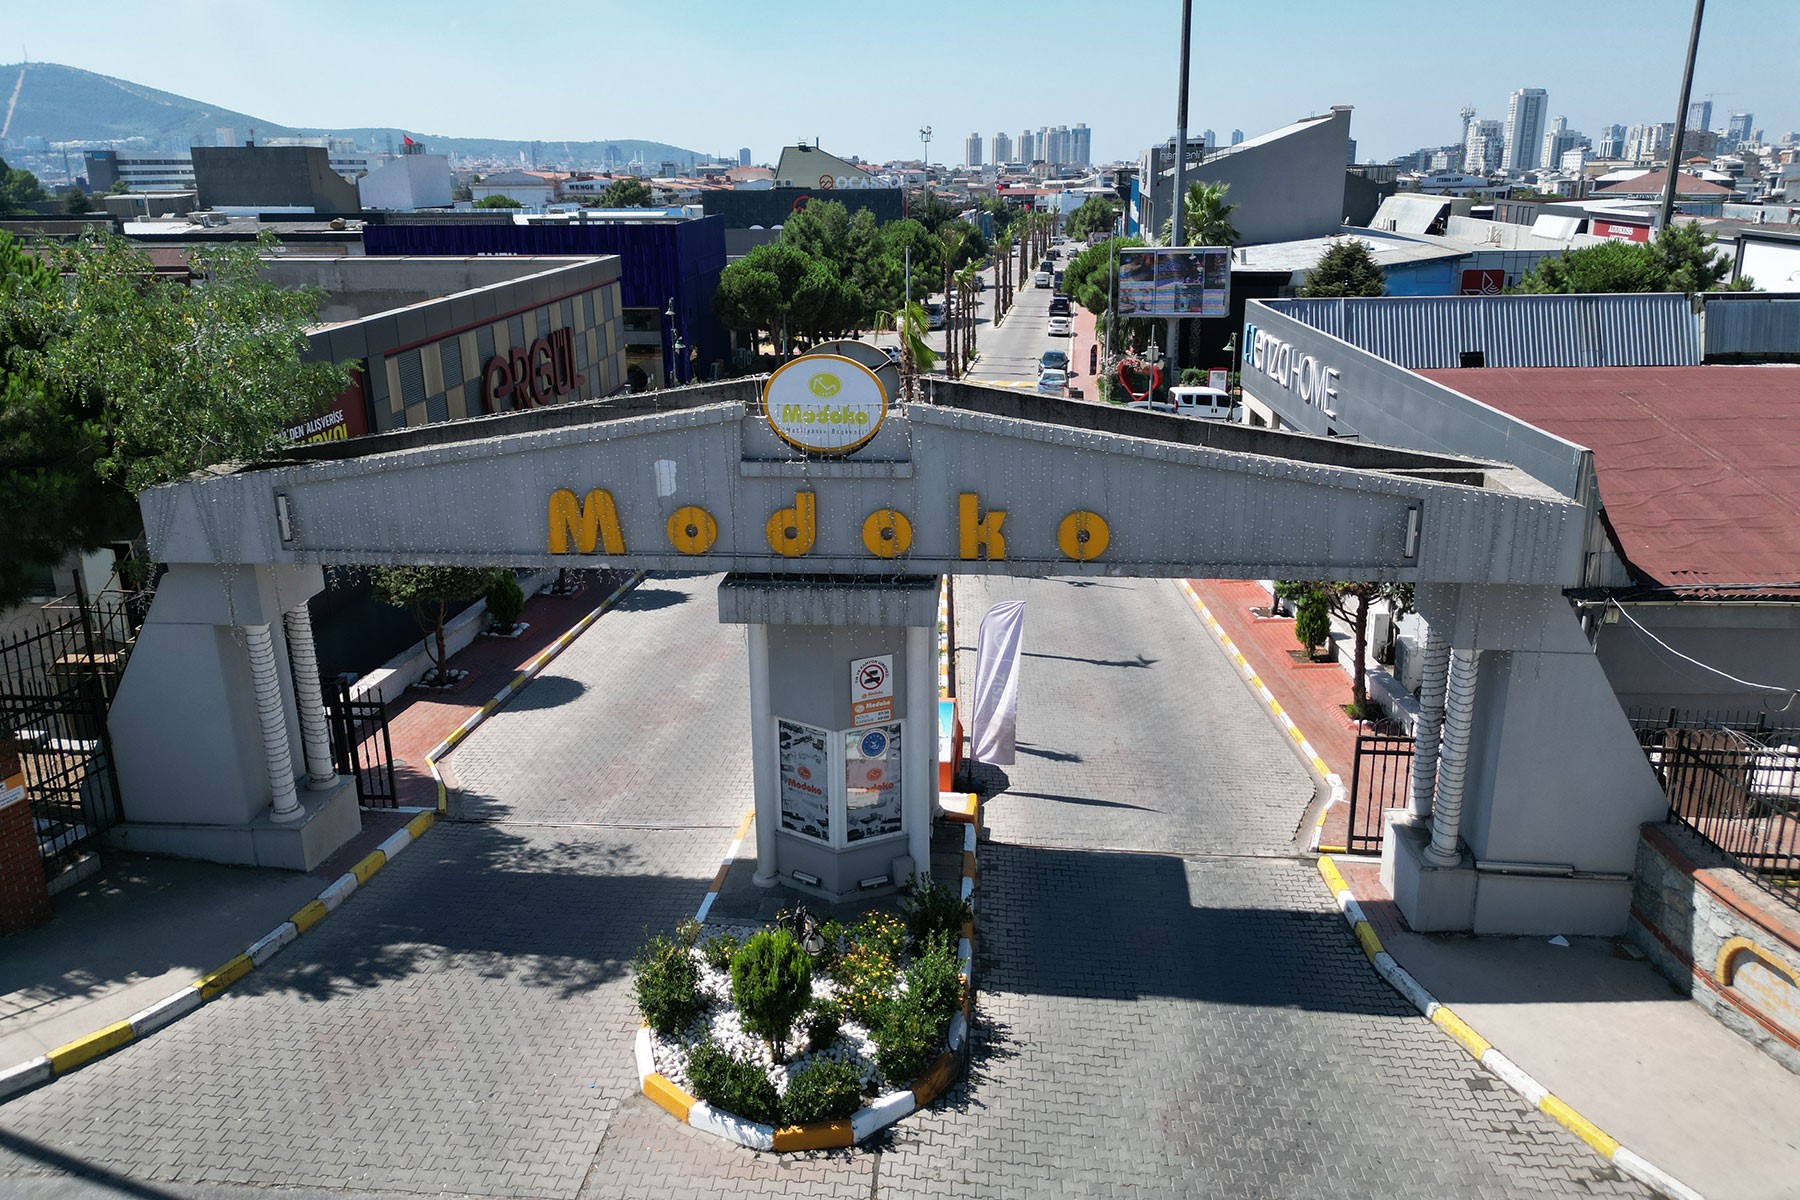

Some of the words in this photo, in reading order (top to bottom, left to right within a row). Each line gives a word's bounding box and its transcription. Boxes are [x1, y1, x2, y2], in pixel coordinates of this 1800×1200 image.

[836, 176, 901, 189] OCASSO
[782, 404, 869, 425] Modoko
[547, 488, 1110, 561] Modoko
[866, 700, 891, 709] Modoko
[787, 778, 822, 795] Modoko
